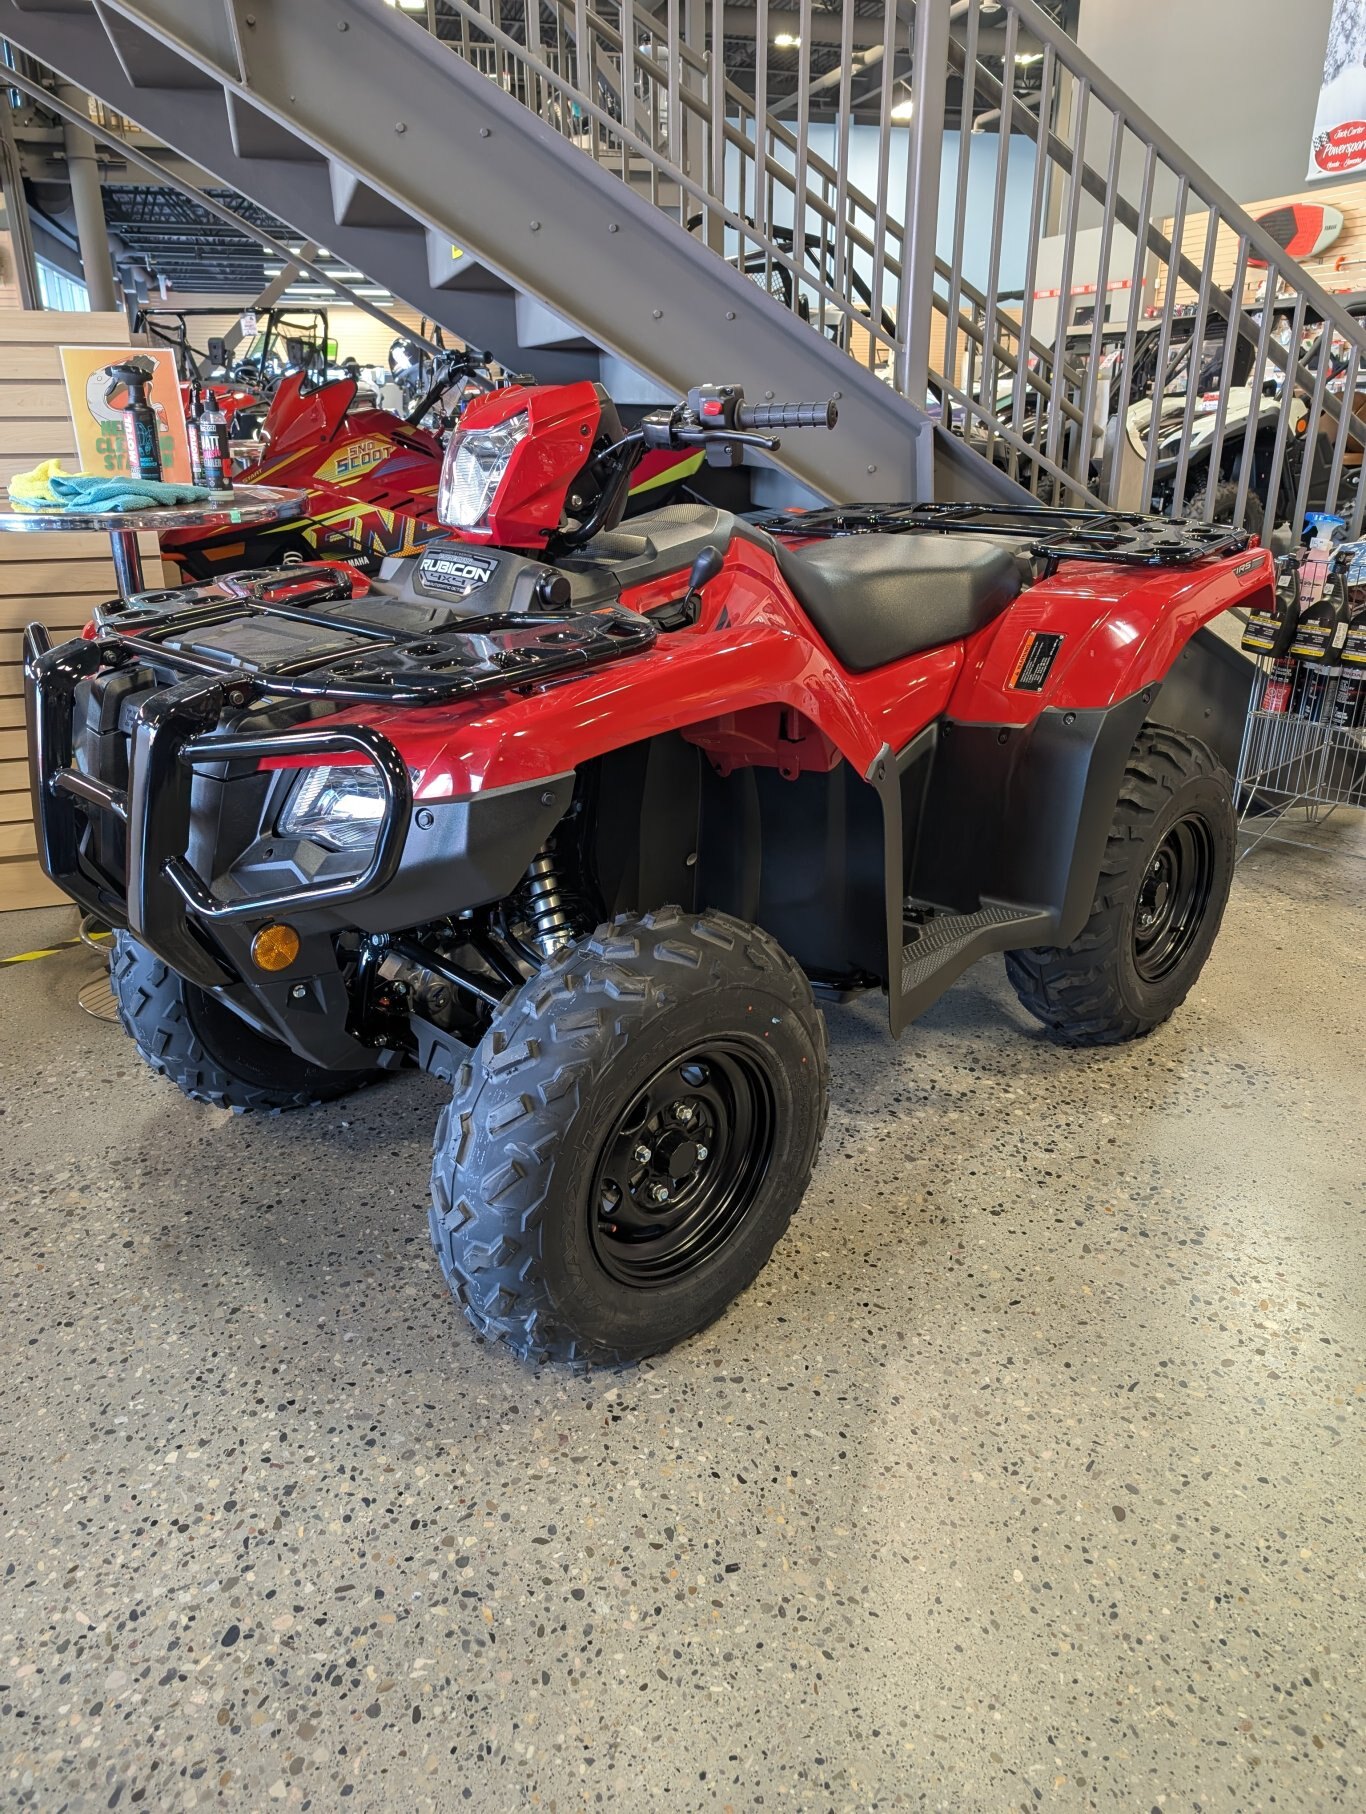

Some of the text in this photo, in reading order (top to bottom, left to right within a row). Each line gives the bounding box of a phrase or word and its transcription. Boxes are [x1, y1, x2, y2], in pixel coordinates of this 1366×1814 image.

[125, 415, 138, 463] MOTUL
[335, 446, 394, 475] SCOOT
[420, 559, 492, 583] RUBICON
[1235, 561, 1252, 575] IRS
